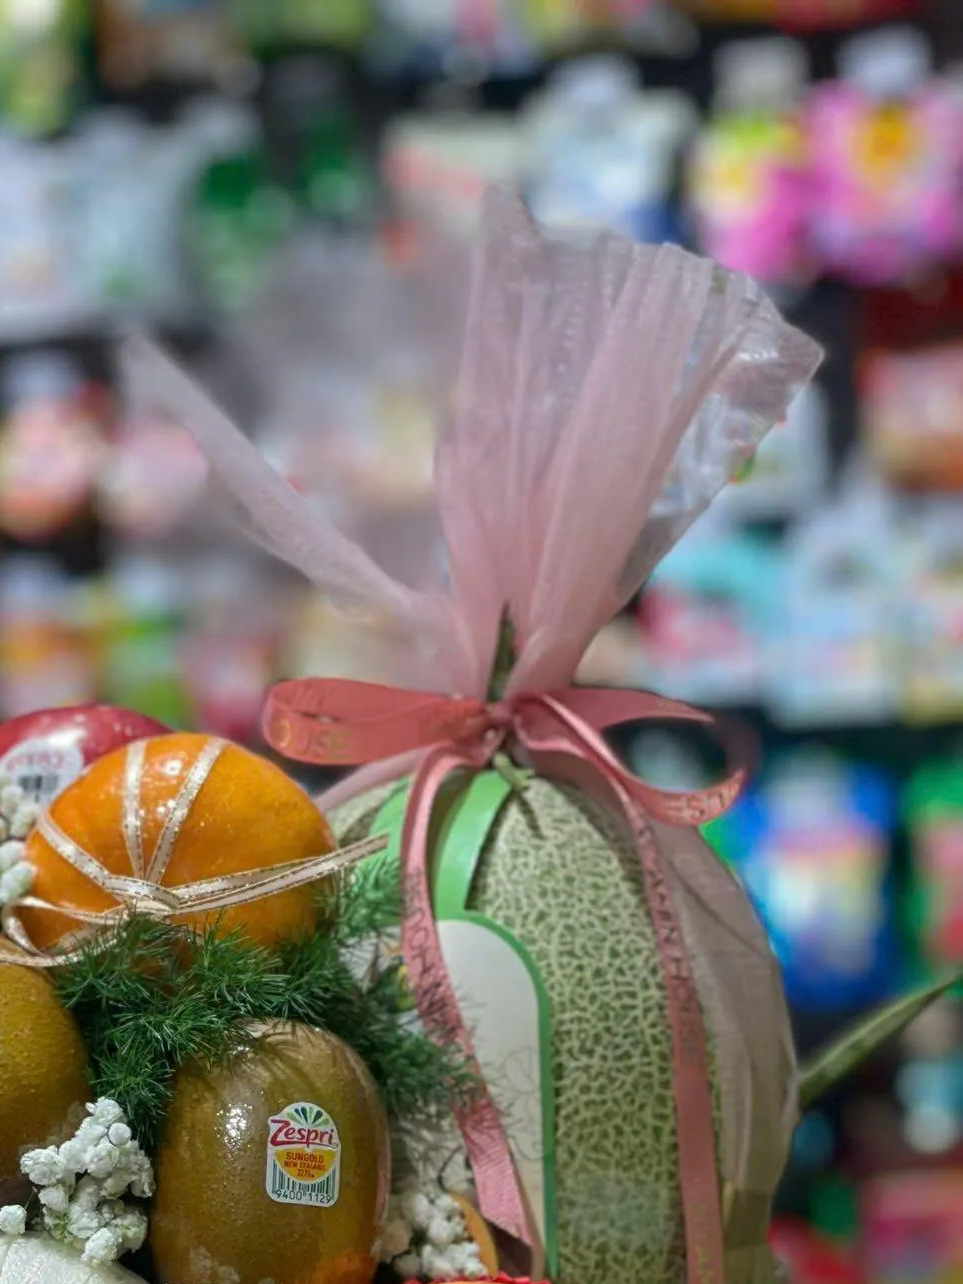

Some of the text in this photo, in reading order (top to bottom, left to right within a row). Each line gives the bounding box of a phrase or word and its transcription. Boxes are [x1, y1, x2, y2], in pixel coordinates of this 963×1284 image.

[270, 1118, 335, 1148] Zespri
[286, 1151, 325, 1164] SUNGOLD
[276, 1188, 333, 1204] 9400 1129
